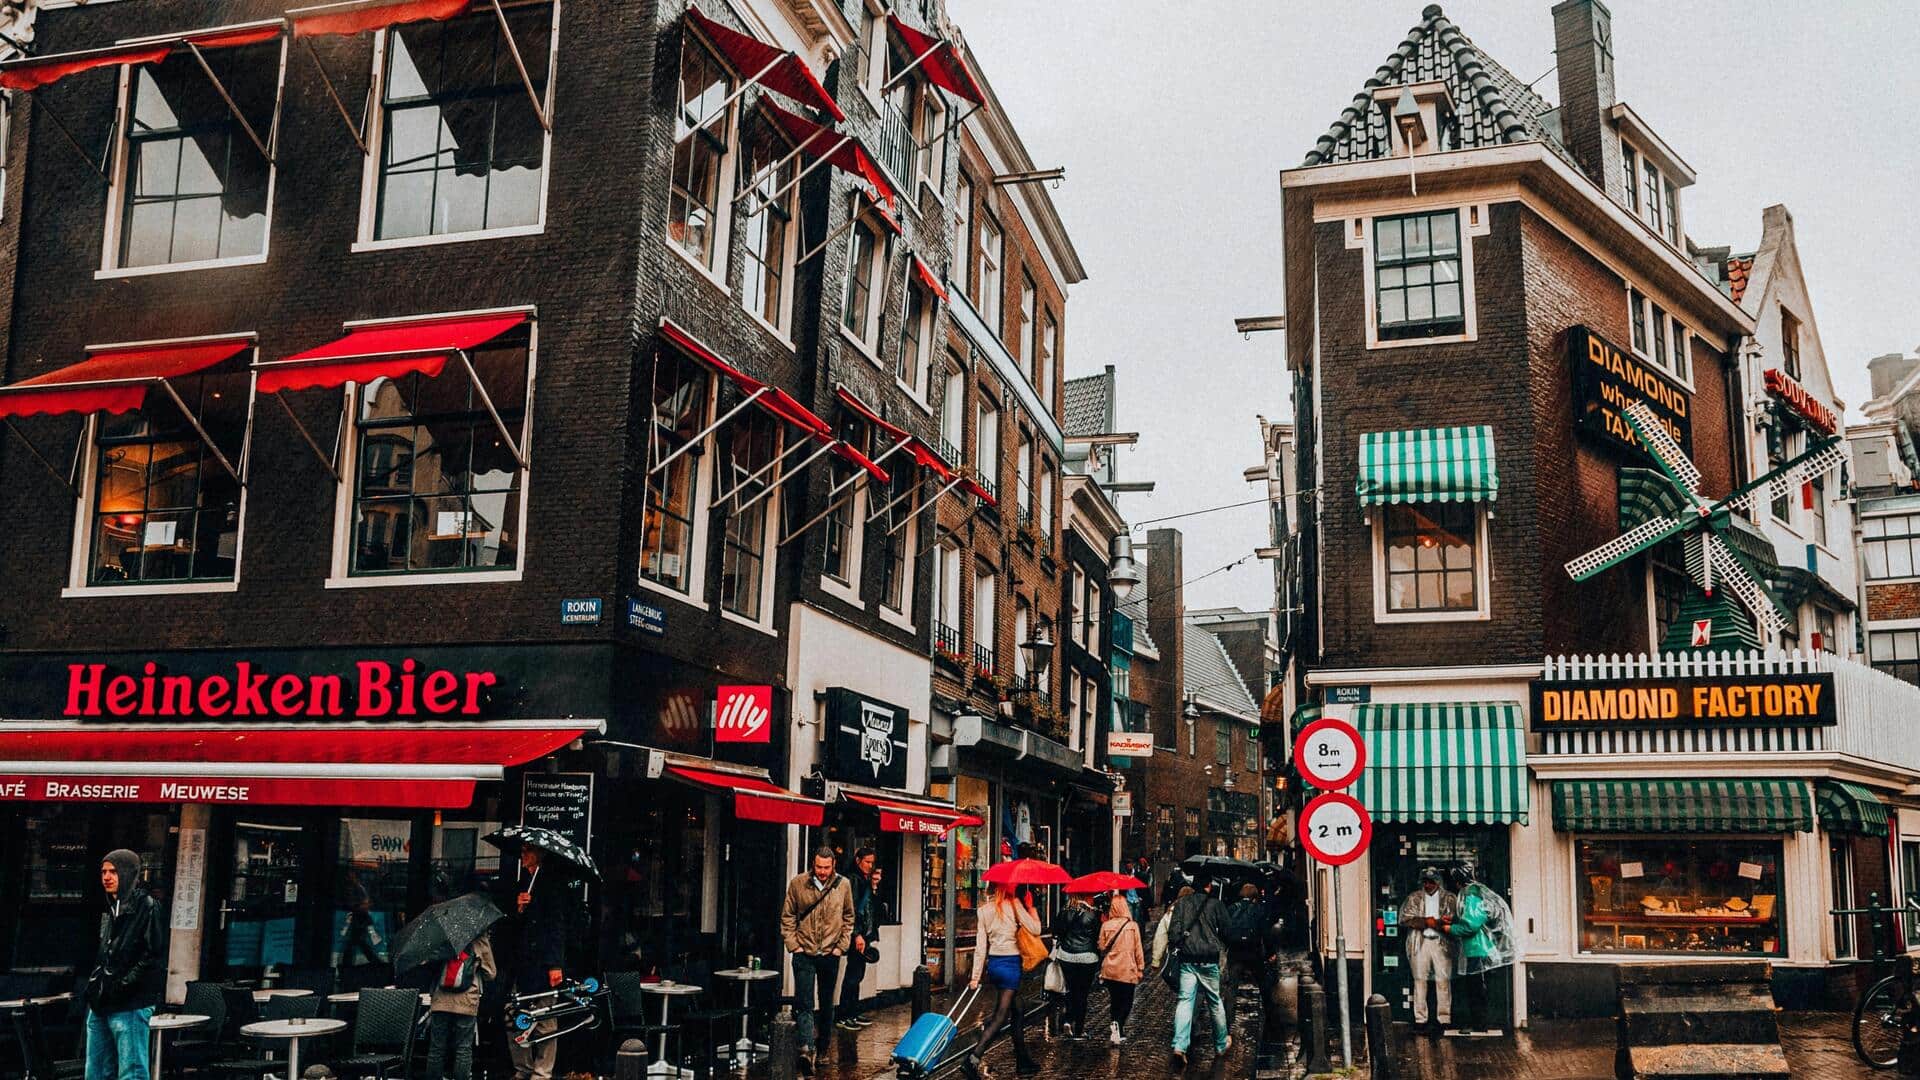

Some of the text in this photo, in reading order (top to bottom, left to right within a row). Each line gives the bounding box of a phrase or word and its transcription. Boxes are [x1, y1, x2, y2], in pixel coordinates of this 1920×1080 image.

[1588, 335, 1686, 418] DIAMOND
[567, 602, 596, 613] ROKIN
[63, 658, 497, 717] Heineken Bier
[1336, 687, 1360, 696] ROKIN
[1542, 684, 1822, 721] DIAMOND FACTORY
[719, 693, 768, 737] illy
[1318, 824, 1353, 838] 2 m
